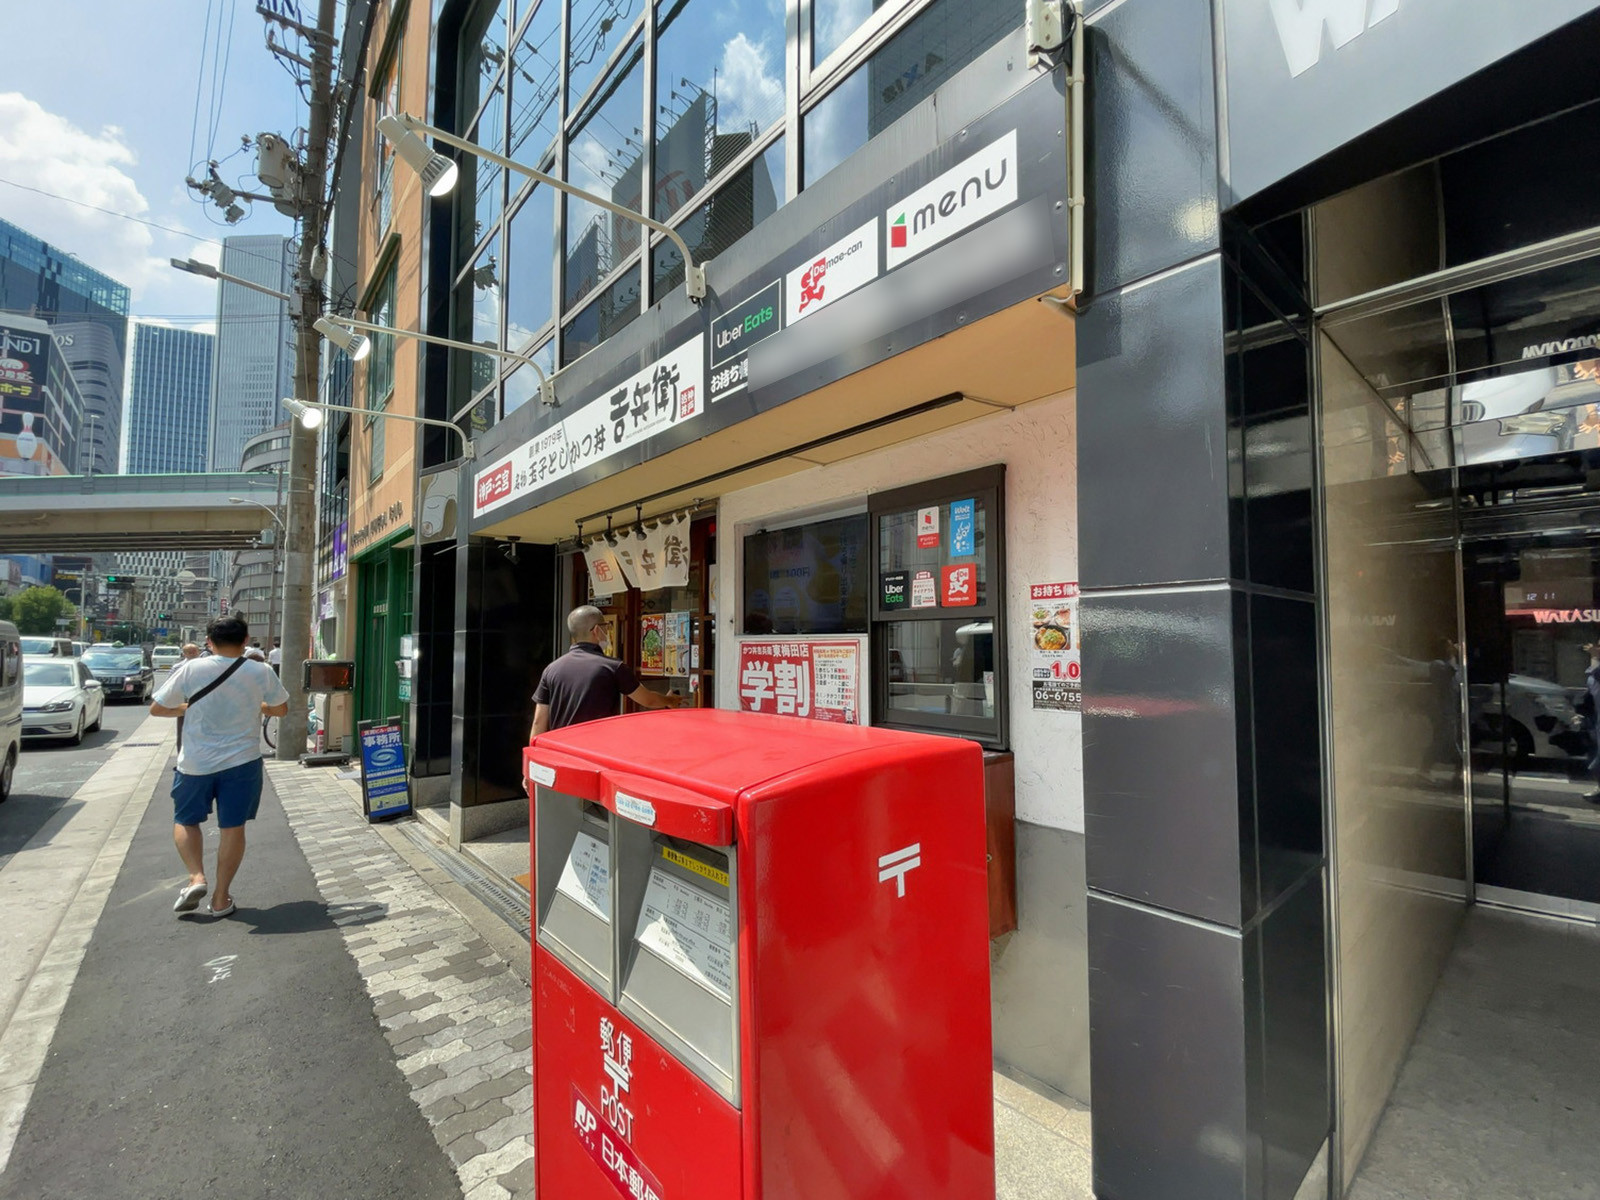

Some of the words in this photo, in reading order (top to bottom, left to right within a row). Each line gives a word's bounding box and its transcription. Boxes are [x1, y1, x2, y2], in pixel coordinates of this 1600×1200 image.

[913, 158, 1007, 235] menu
[716, 324, 743, 348] Uber
[744, 306, 773, 333] Eats
[610, 364, 680, 444] 吉兵衛
[885, 584, 904, 594] Uber
[885, 594, 904, 603] Eats
[742, 660, 810, 717] 学割
[363, 731, 400, 747] 事務所
[600, 1016, 633, 1078] 郵便
[601, 1085, 634, 1144] POST
